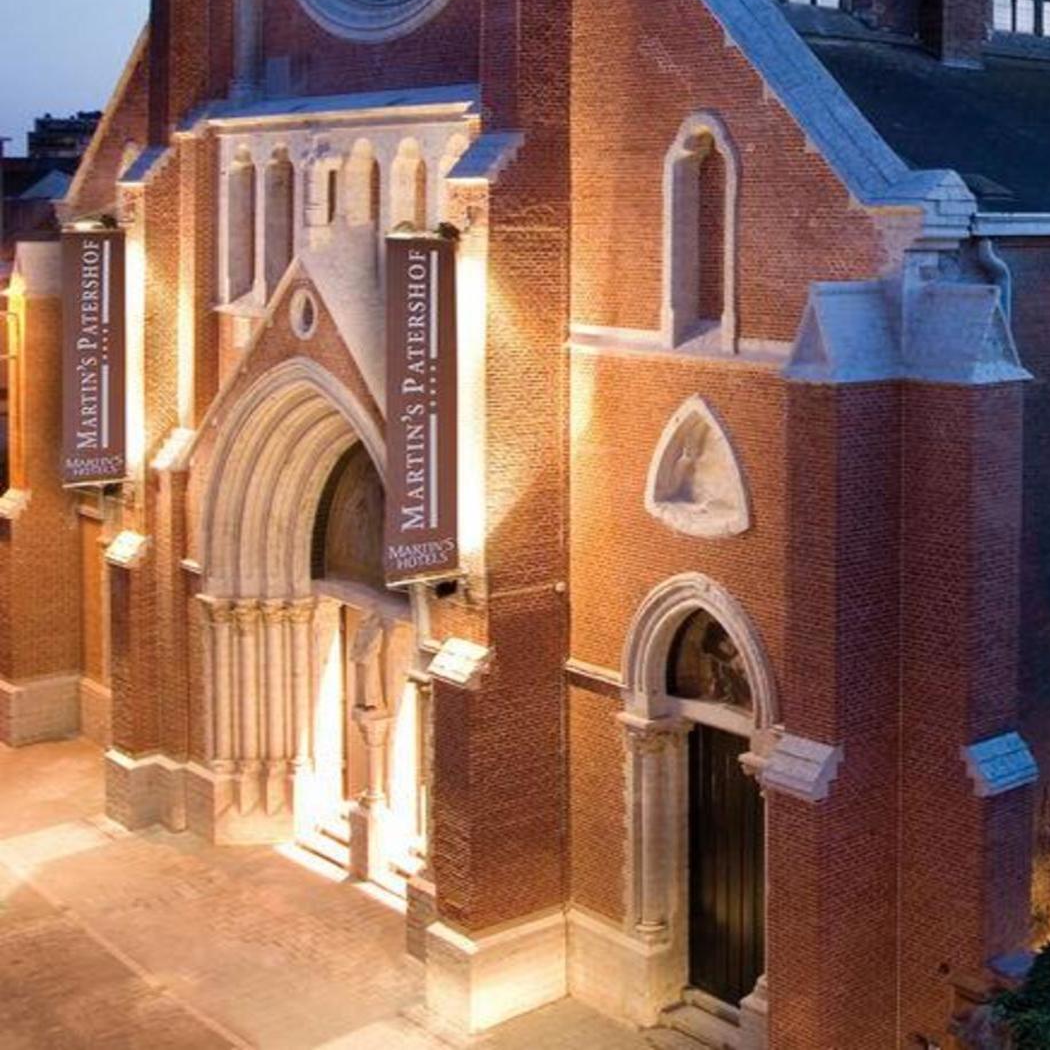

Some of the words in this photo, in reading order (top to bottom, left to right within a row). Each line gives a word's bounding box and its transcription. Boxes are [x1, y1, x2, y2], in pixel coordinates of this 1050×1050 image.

[77, 240, 99, 350] PATERSHOF
[402, 249, 427, 394] PATERSHOF
[401, 403, 425, 532] MARTIN'S
